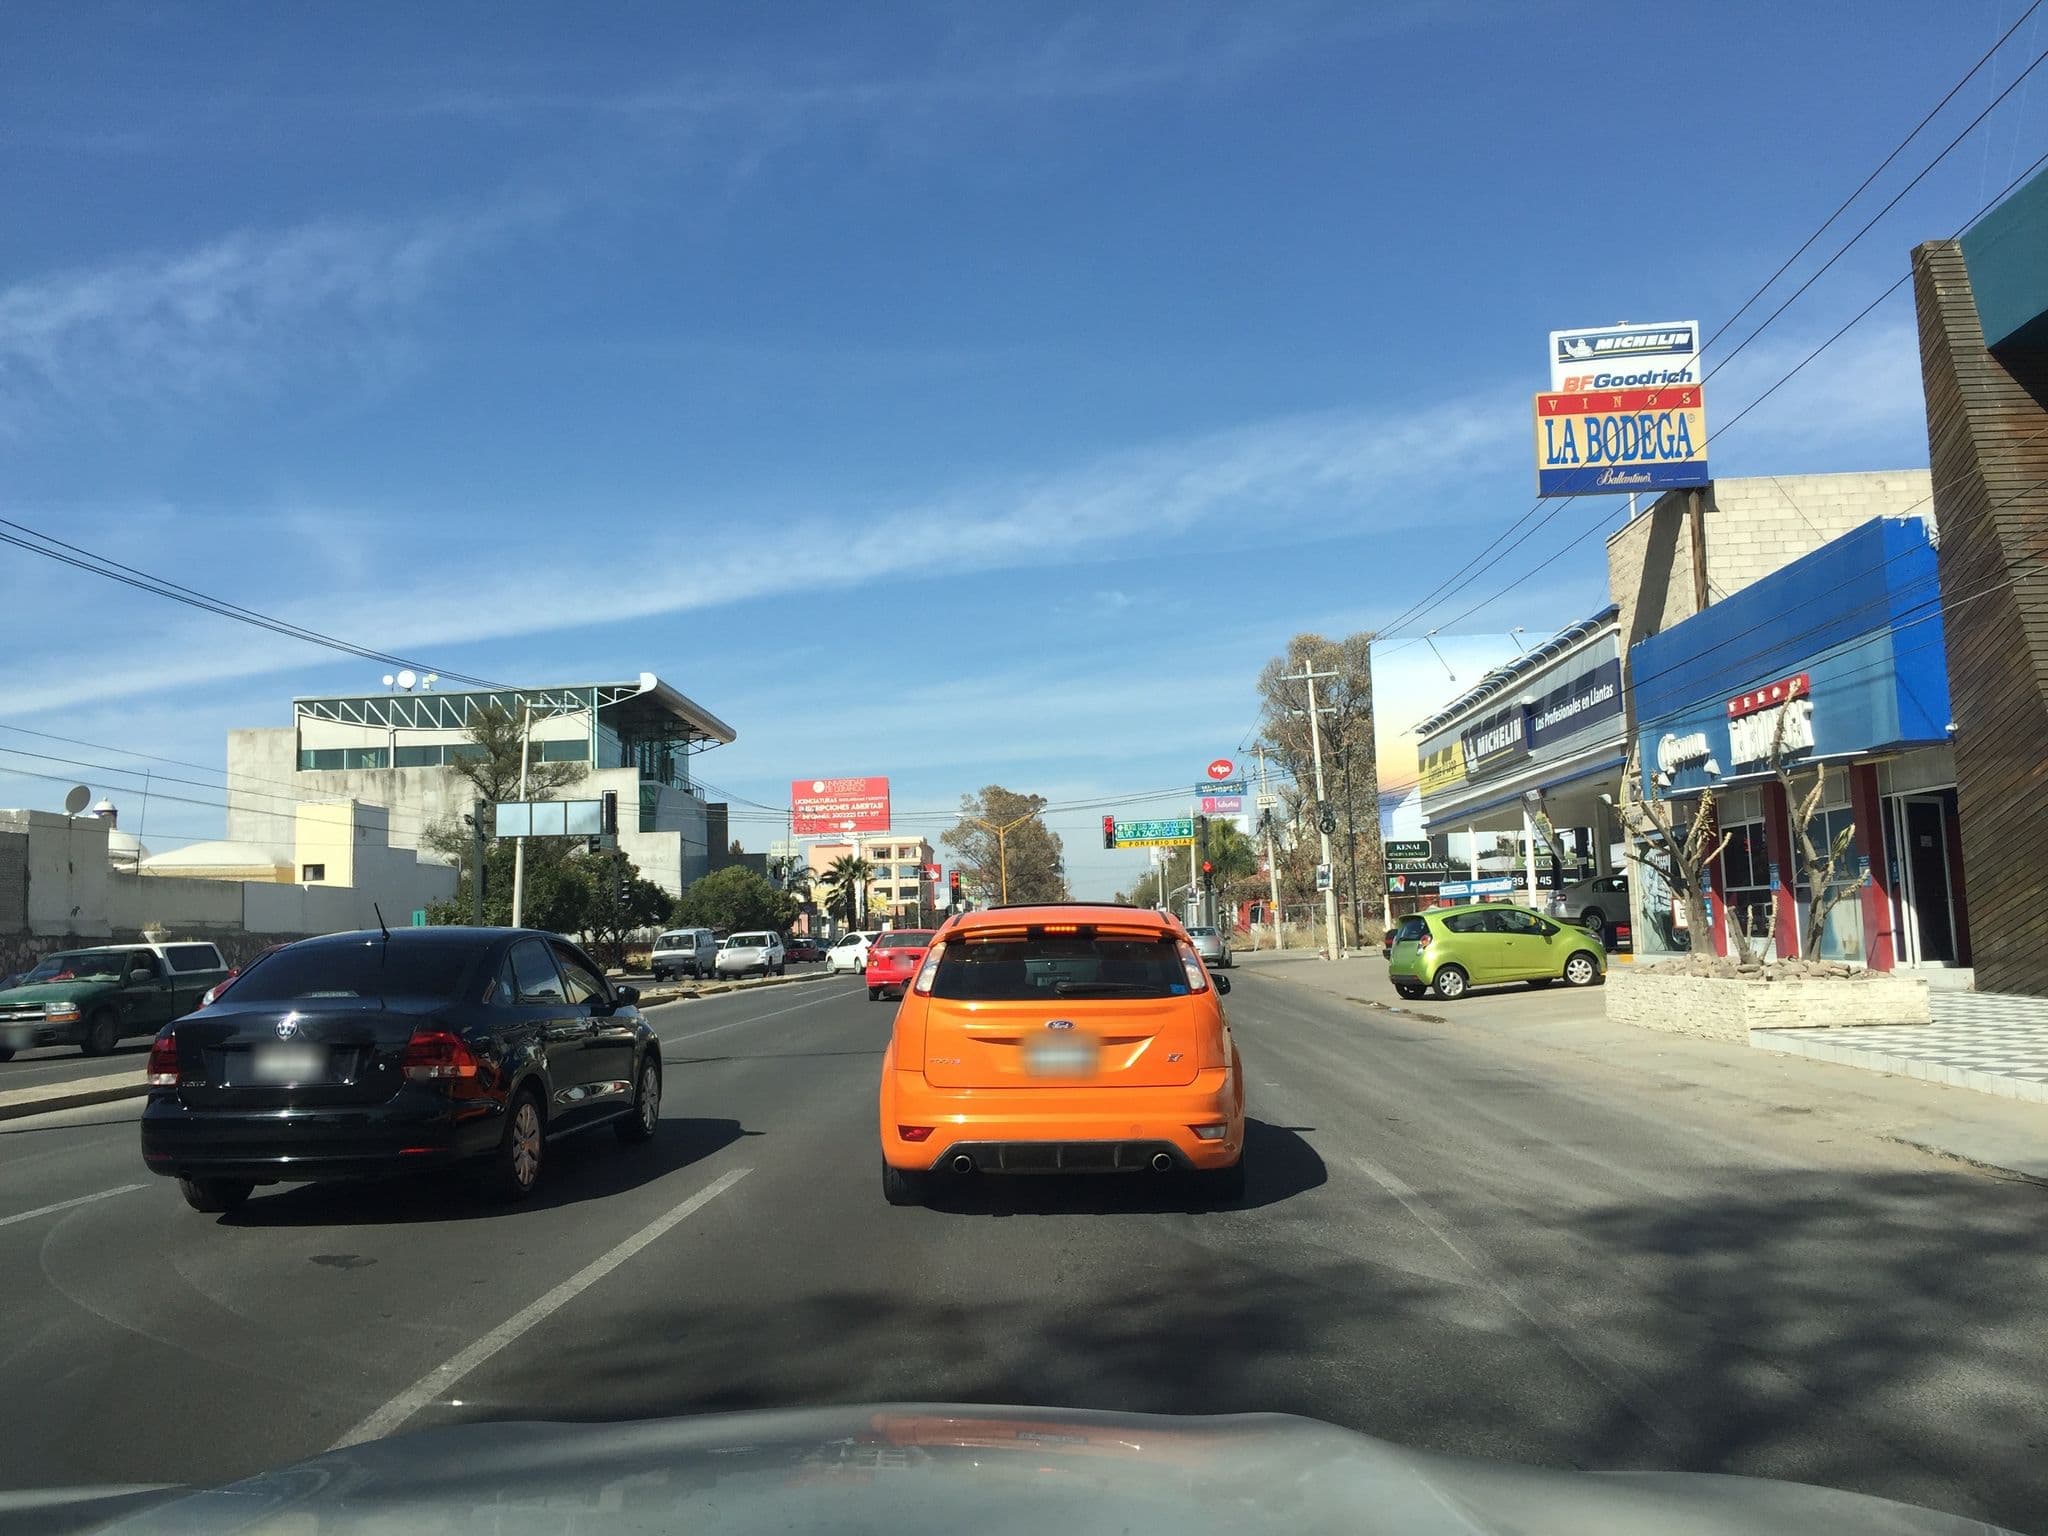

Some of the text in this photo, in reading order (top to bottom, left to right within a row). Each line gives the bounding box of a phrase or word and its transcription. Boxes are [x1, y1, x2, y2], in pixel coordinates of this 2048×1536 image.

[1594, 333, 1690, 351] MICHELIN
[1562, 368, 1693, 391] BFGoodrich
[1548, 392, 1691, 412] VINOS
[1545, 412, 1695, 465] LA BODEGA
[1535, 683, 1614, 731] Los Profesionales en Llantas
[1477, 717, 1522, 757] MICHELIN
[1211, 765, 1231, 774] vips
[1128, 839, 1170, 847] PORFIRIO
[1387, 861, 1449, 870] 3 RECAMARAS
